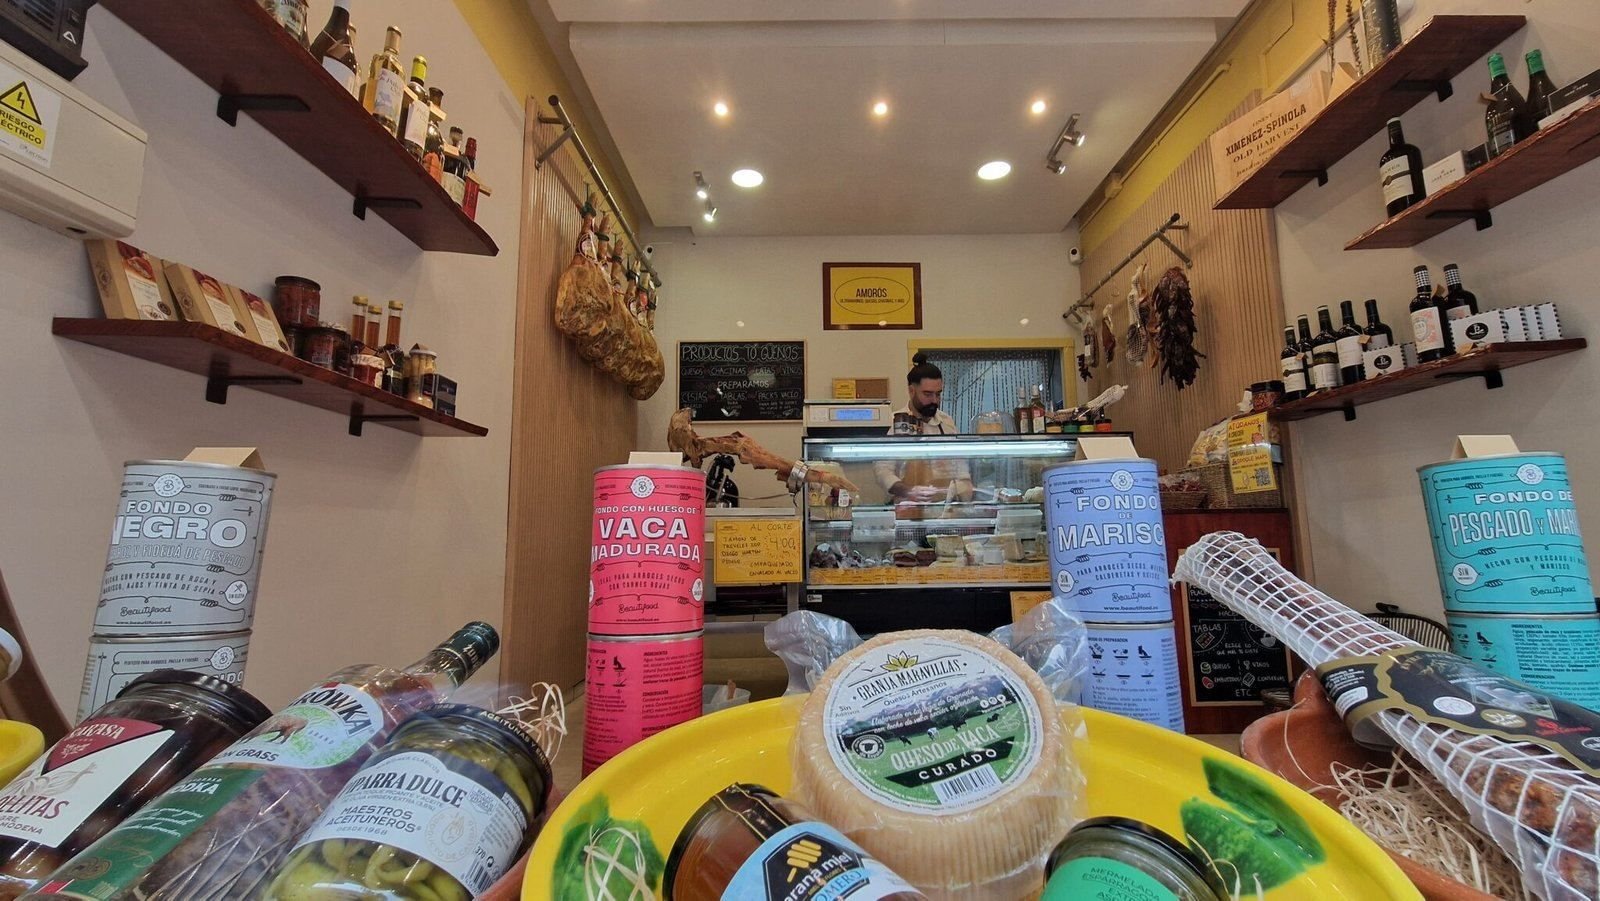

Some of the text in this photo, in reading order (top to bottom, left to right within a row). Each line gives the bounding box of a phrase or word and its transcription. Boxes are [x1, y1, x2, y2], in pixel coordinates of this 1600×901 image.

[0, 109, 35, 132] RIESGO
[1233, 149, 1253, 163] OLD
[1257, 123, 1299, 151] HARVEST
[682, 346, 739, 360] PRODUCTOS
[710, 366, 747, 376] CHACINAS
[718, 380, 769, 389] PREPARAMOS
[1077, 495, 1158, 512] FONDO
[1475, 491, 1573, 505] FONDO DE
[126, 500, 212, 515] FONDO
[648, 505, 685, 513] HUESO
[599, 518, 689, 540] VACA
[767, 523, 793, 531] CORTE
[1449, 509, 1545, 546] PESCADO Y
[185, 547, 201, 560] DE
[1076, 568, 1092, 577] PARA
[1095, 563, 1124, 573] ARROCES
[1485, 559, 1511, 570] HECHO
[1515, 556, 1531, 564] CON
[120, 573, 132, 581] CON
[136, 572, 171, 580] PESCADO
[175, 573, 185, 581] DE
[189, 575, 209, 585] ROCA
[614, 572, 630, 580] PARA
[633, 572, 663, 580] ARROCES
[1060, 574, 1069, 583] SIN
[1095, 571, 1135, 581] CALDERETAS
[1458, 567, 1469, 576] SIN
[193, 586, 215, 595] SEPIA
[1192, 624, 1222, 633] TABLAS
[856, 659, 961, 701] GRANJA MARAVILLAS
[911, 681, 948, 697] Artesanos
[1235, 689, 1252, 697] ETC
[479, 710, 531, 744] ACEITUNAS
[890, 723, 1001, 770] QUESO DE VACA
[236, 749, 279, 762] GRASS
[918, 749, 998, 780] CURADO
[406, 774, 468, 809] DULCE
[340, 805, 413, 821] MAESTROS
[364, 827, 388, 836] 1968
[821, 851, 853, 872] miel
